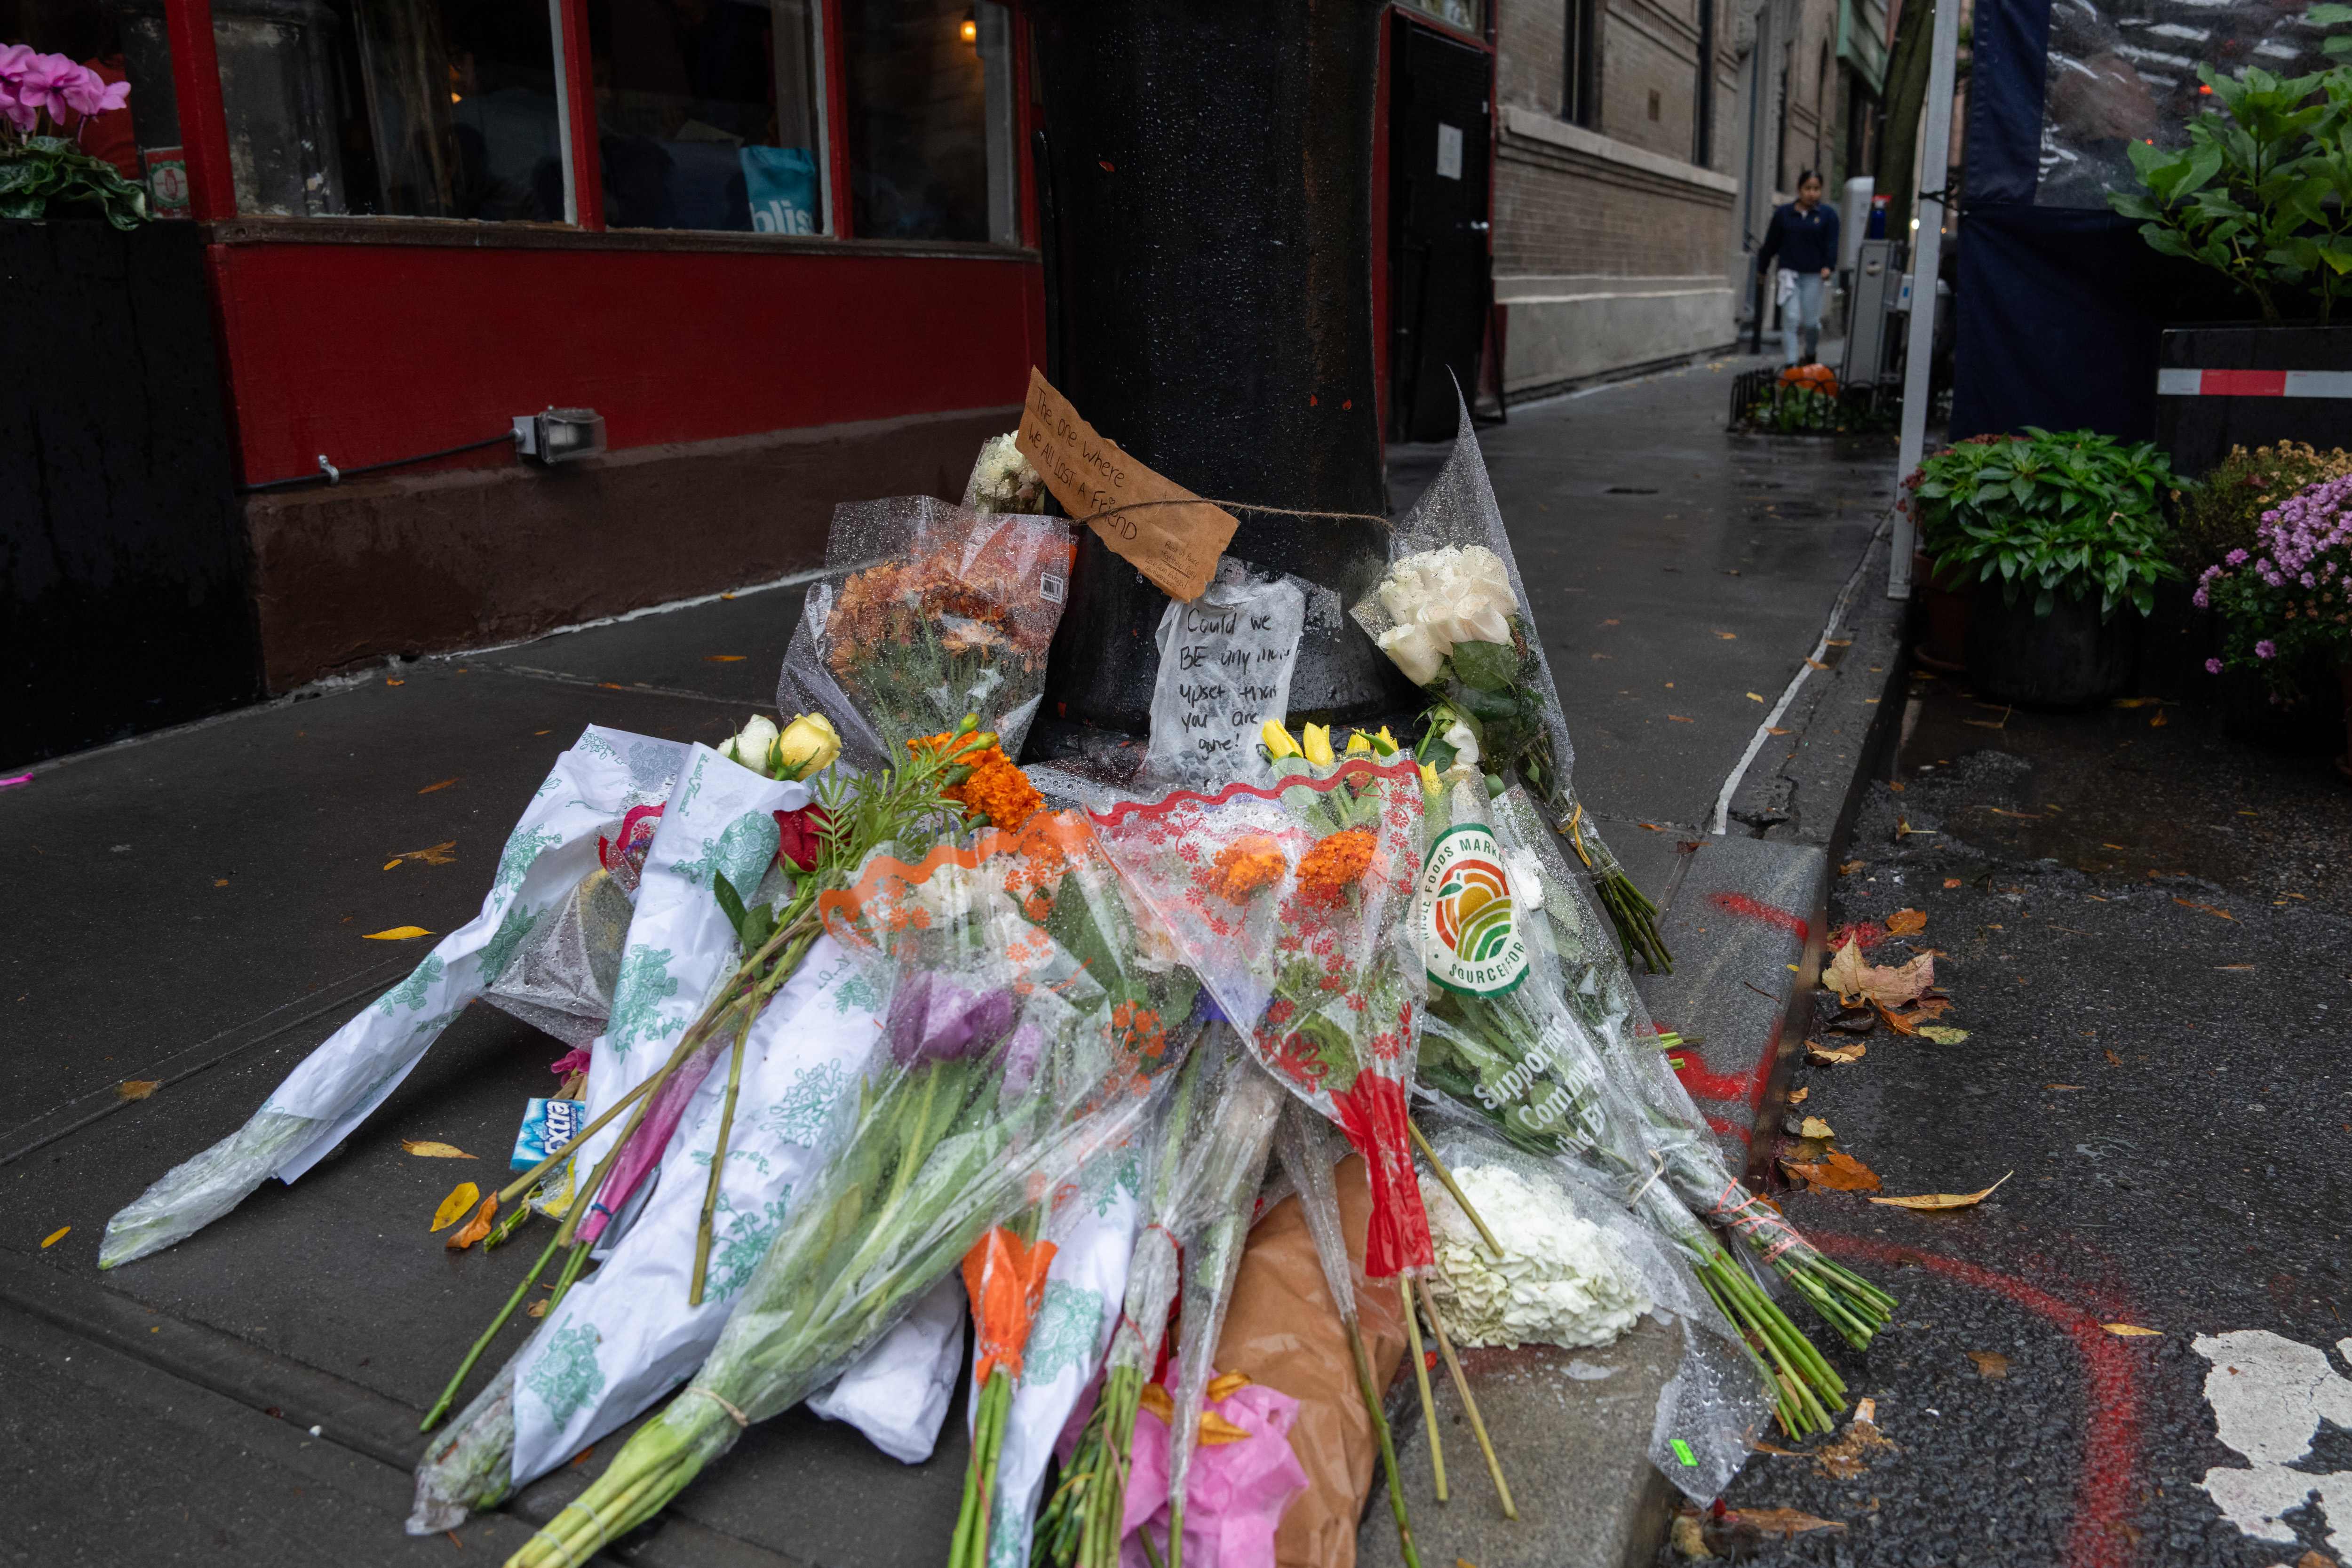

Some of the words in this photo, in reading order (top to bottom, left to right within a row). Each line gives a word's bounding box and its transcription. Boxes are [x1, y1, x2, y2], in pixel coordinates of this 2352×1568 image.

[1038, 386, 1052, 425] The
[1078, 482, 1086, 500] A
[1187, 608, 1237, 635] Could
[1180, 646, 1208, 670] BE
[1221, 649, 1251, 675] any
[1180, 684, 1225, 708] upset
[1181, 712, 1208, 733] you
[1232, 711, 1258, 727] are
[1424, 846, 1454, 893] FOODS
[1459, 838, 1506, 865] MARKE
[1505, 942, 1525, 970] FOR
